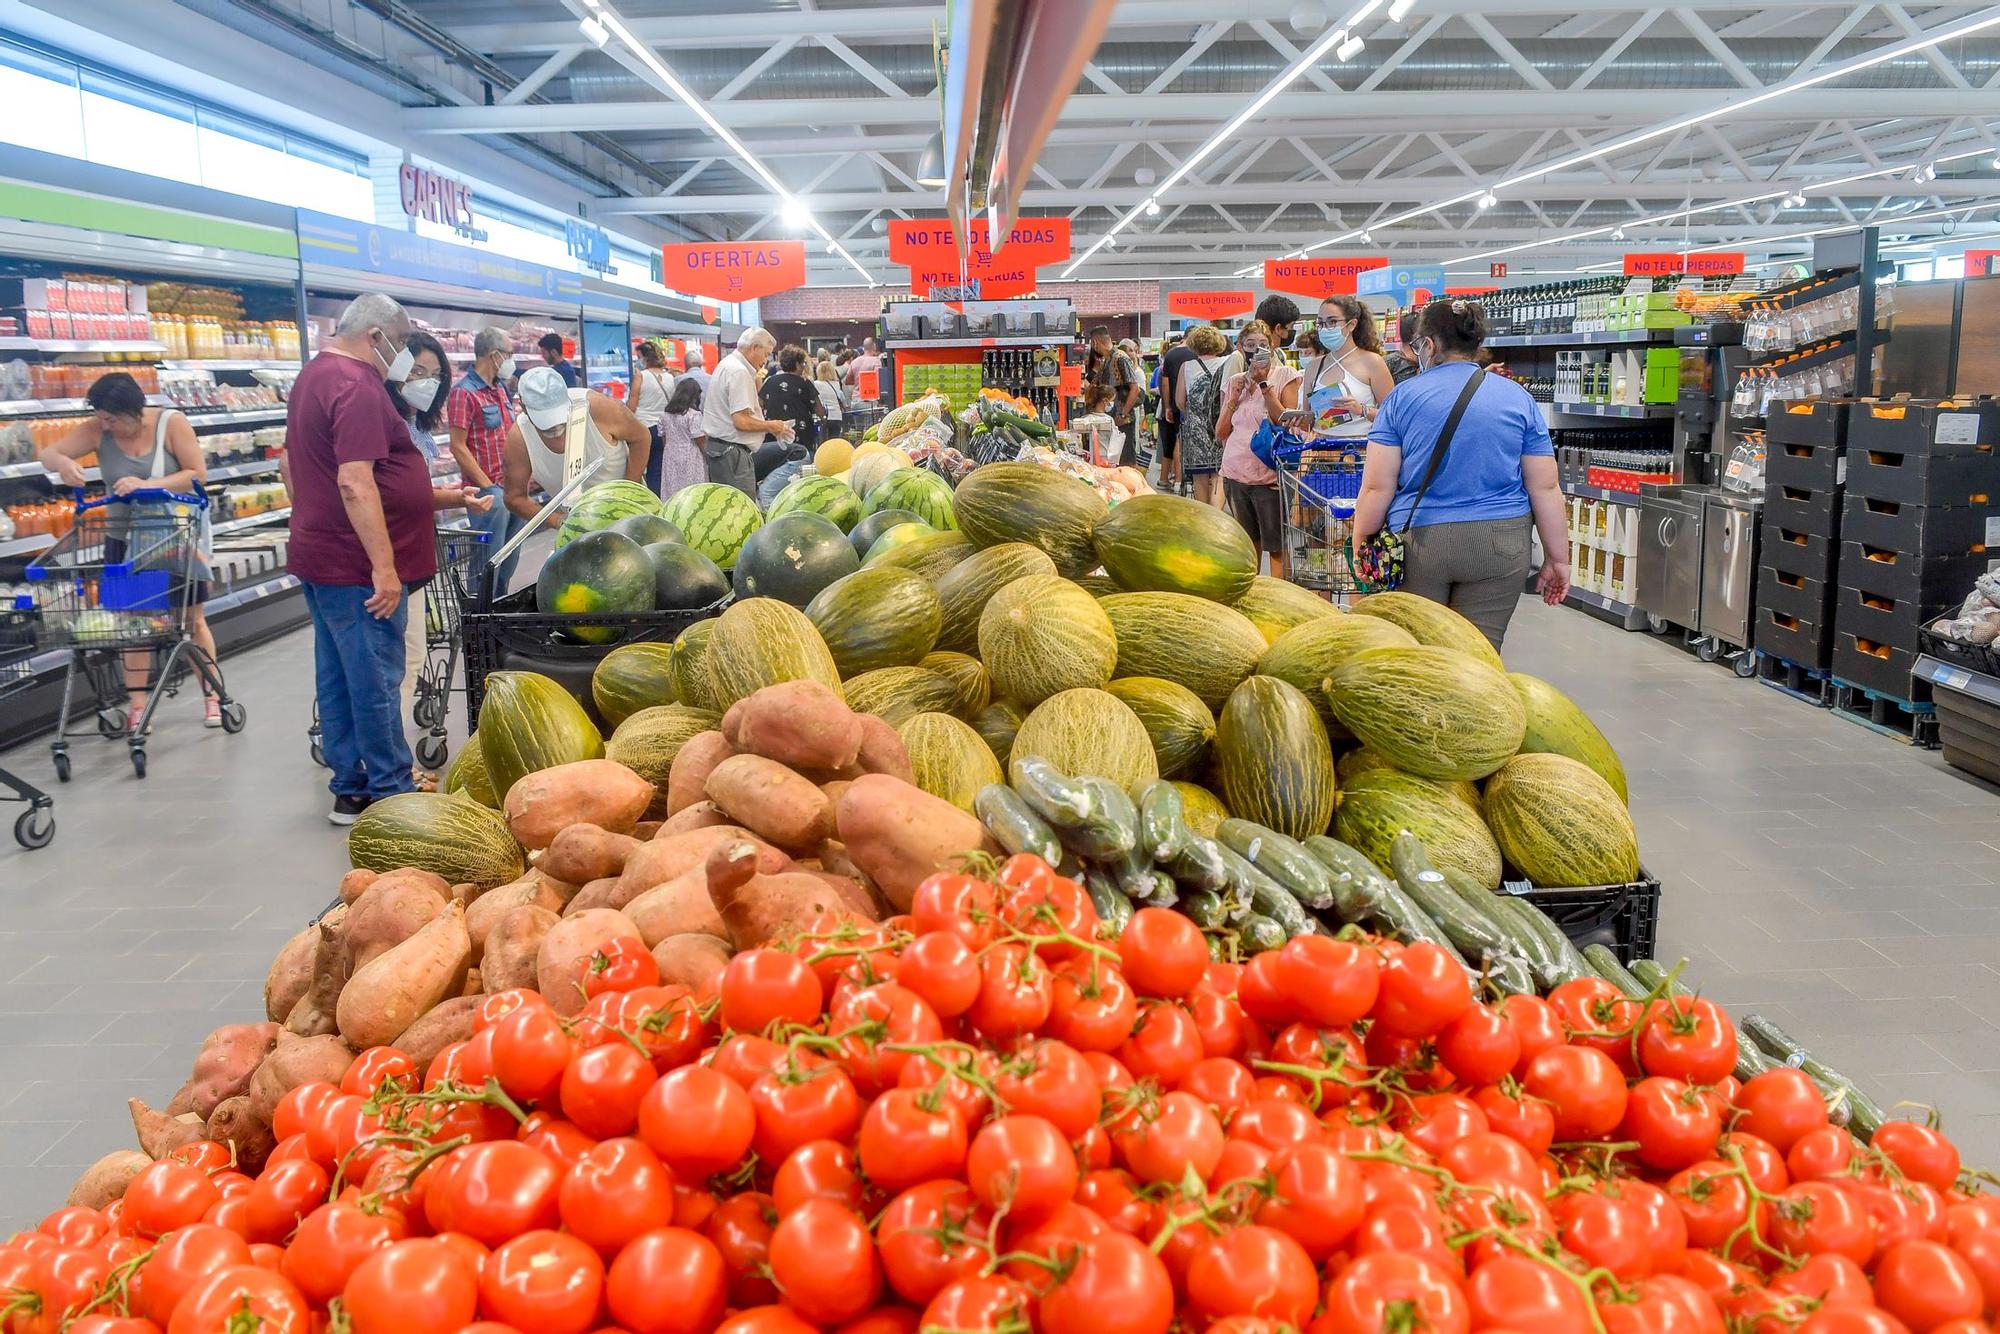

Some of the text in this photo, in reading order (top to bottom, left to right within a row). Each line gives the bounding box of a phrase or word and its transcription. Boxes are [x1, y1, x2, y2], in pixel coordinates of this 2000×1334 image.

[400, 163, 474, 226] CARNES
[906, 231, 928, 245] NO
[933, 231, 952, 245] TE
[984, 230, 1054, 244] PRDAS
[687, 249, 781, 268] OFERTAS
[1275, 267, 1291, 276] NO
[1294, 267, 1307, 276] TE
[1311, 266, 1326, 276] LO
[1634, 260, 1734, 271] NO TE LO PIERDAS
[922, 272, 937, 282] NO
[942, 272, 954, 282] TE
[1176, 297, 1187, 305] NO
[1190, 297, 1200, 305] TE
[1213, 296, 1247, 304] PIERDAS
